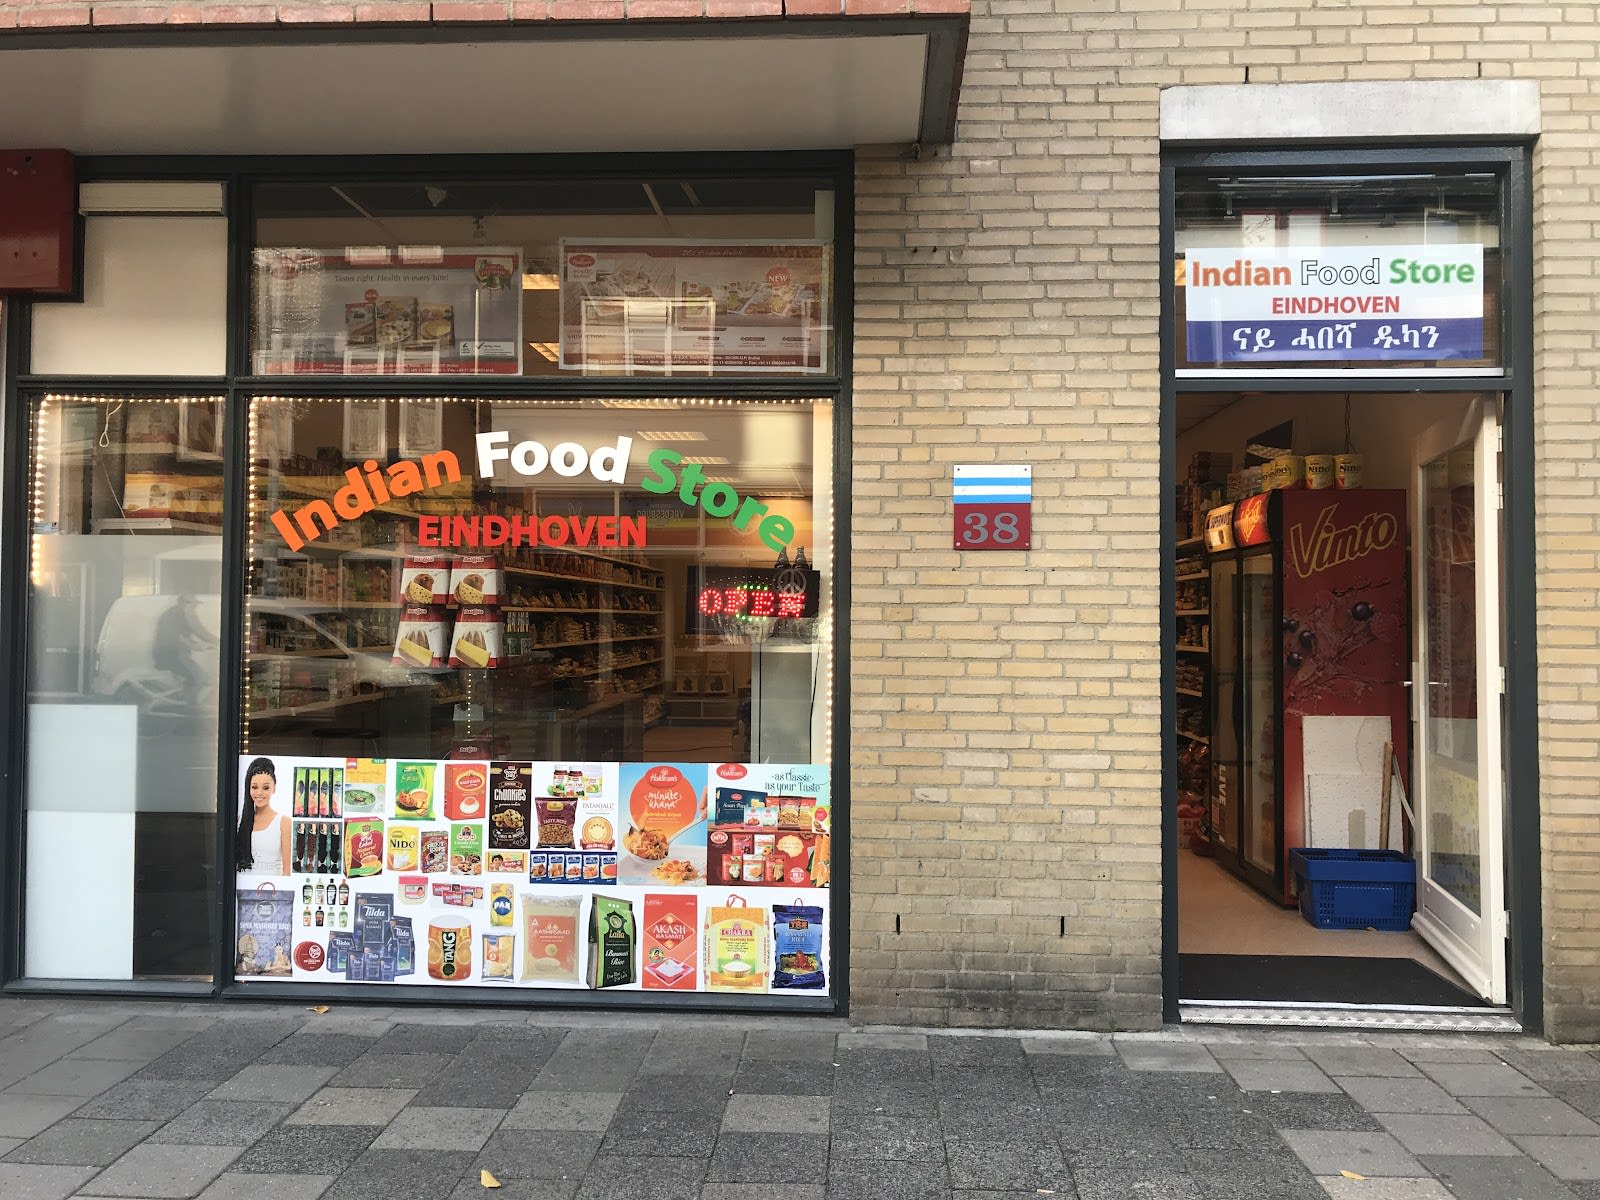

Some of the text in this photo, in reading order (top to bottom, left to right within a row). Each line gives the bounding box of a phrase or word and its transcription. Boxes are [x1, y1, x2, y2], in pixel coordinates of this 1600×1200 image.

[1193, 258, 1475, 286] Indian Food Store
[1272, 296, 1400, 314] EINDHOVEN
[270, 430, 796, 553] Indian Food Store
[418, 515, 647, 549] EINDHOVEN
[963, 512, 1020, 544] 38
[1290, 502, 1398, 578] Vimto
[699, 588, 807, 617] OPEN
[786, 768, 812, 782] Classic
[648, 790, 678, 800] minute
[764, 782, 820, 796] as your Taste
[649, 800, 676, 809] khana
[390, 839, 415, 848] NIDO
[363, 906, 386, 917] Tilda
[394, 928, 410, 937] Tilda
[653, 924, 686, 934] AKASH
[443, 932, 456, 962] TANG
